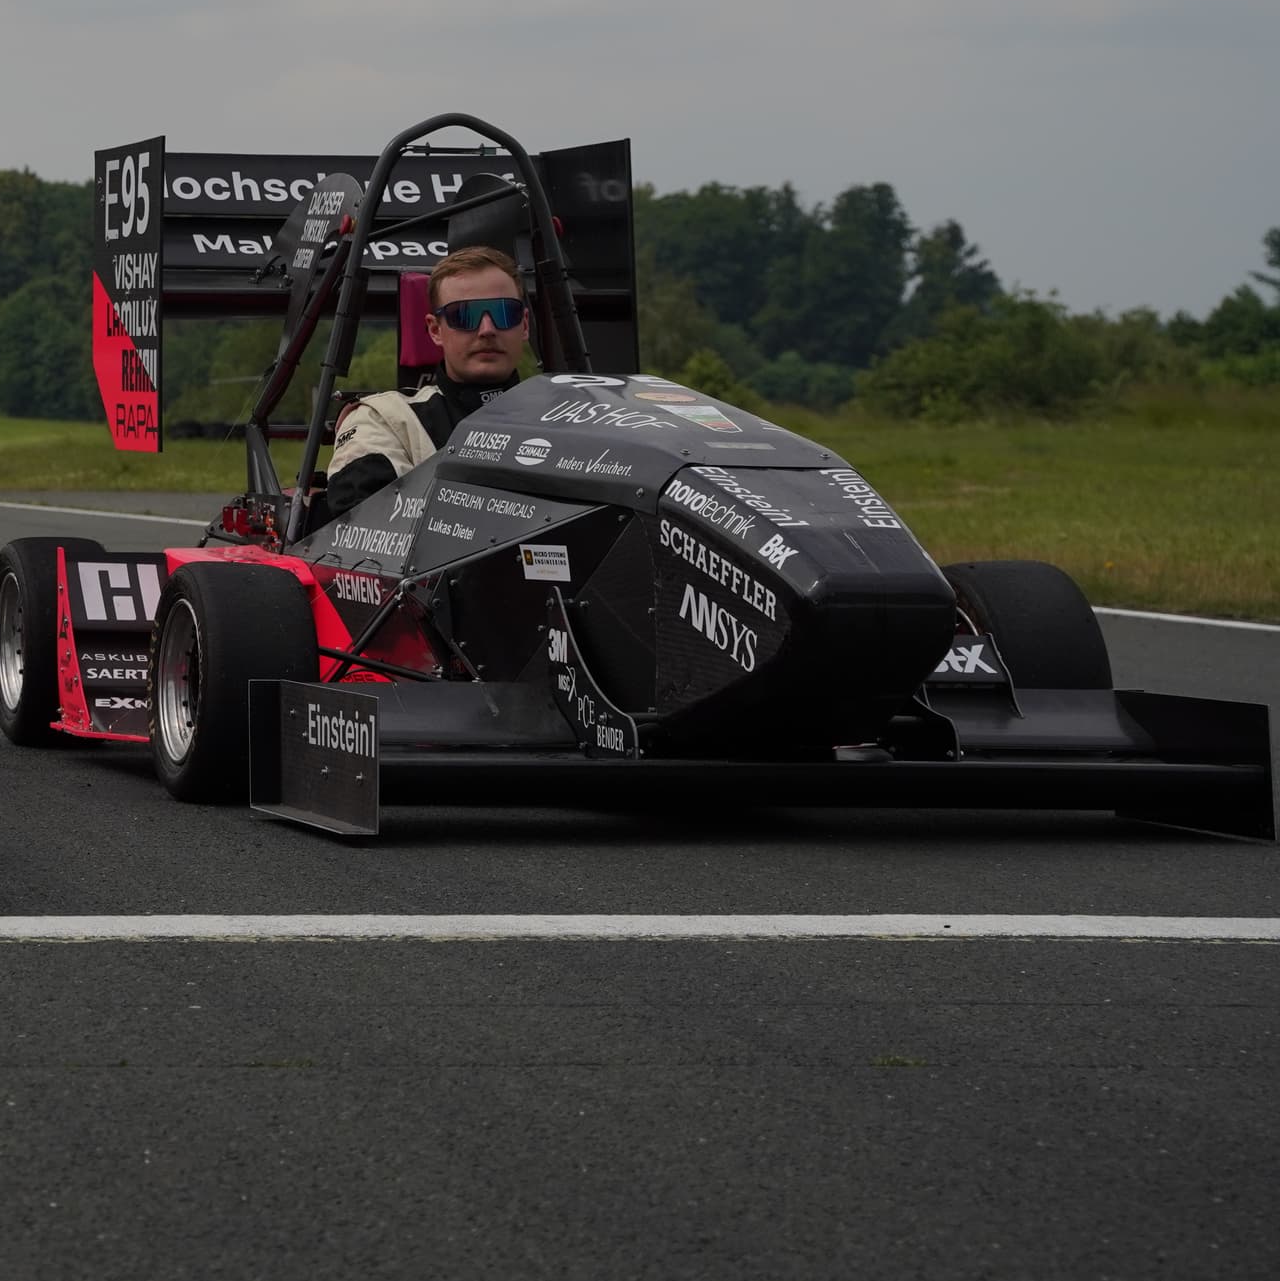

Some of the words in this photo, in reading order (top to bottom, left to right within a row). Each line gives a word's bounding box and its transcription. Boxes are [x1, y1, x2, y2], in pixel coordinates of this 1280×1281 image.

[105, 151, 150, 241] E95
[114, 252, 158, 290] VISHAY
[121, 348, 158, 393] REHAU
[116, 403, 158, 440] RAPA
[540, 400, 611, 424] UAS
[593, 407, 679, 429] HOF
[458, 448, 503, 462] ELECTRONICS
[463, 430, 512, 451] MOUSER
[516, 445, 552, 458] SCHMALZ
[555, 457, 584, 471] Anders
[585, 449, 632, 477] Versichert.
[437, 487, 485, 511] SCHERUHN
[486, 497, 536, 520] CHEMICALS
[664, 478, 755, 540] novotechnik
[690, 465, 810, 527] Einstein1
[818, 467, 902, 530] Einstein1
[427, 516, 453, 536] Lukas
[451, 523, 476, 541] Dietel
[659, 519, 777, 622] SCHAEFFLER
[336, 572, 382, 607] SIEMENS
[548, 627, 568, 664] 3M
[678, 582, 758, 673] ANSYS
[308, 703, 376, 759] Einstein1
[597, 724, 625, 752] BENDER
